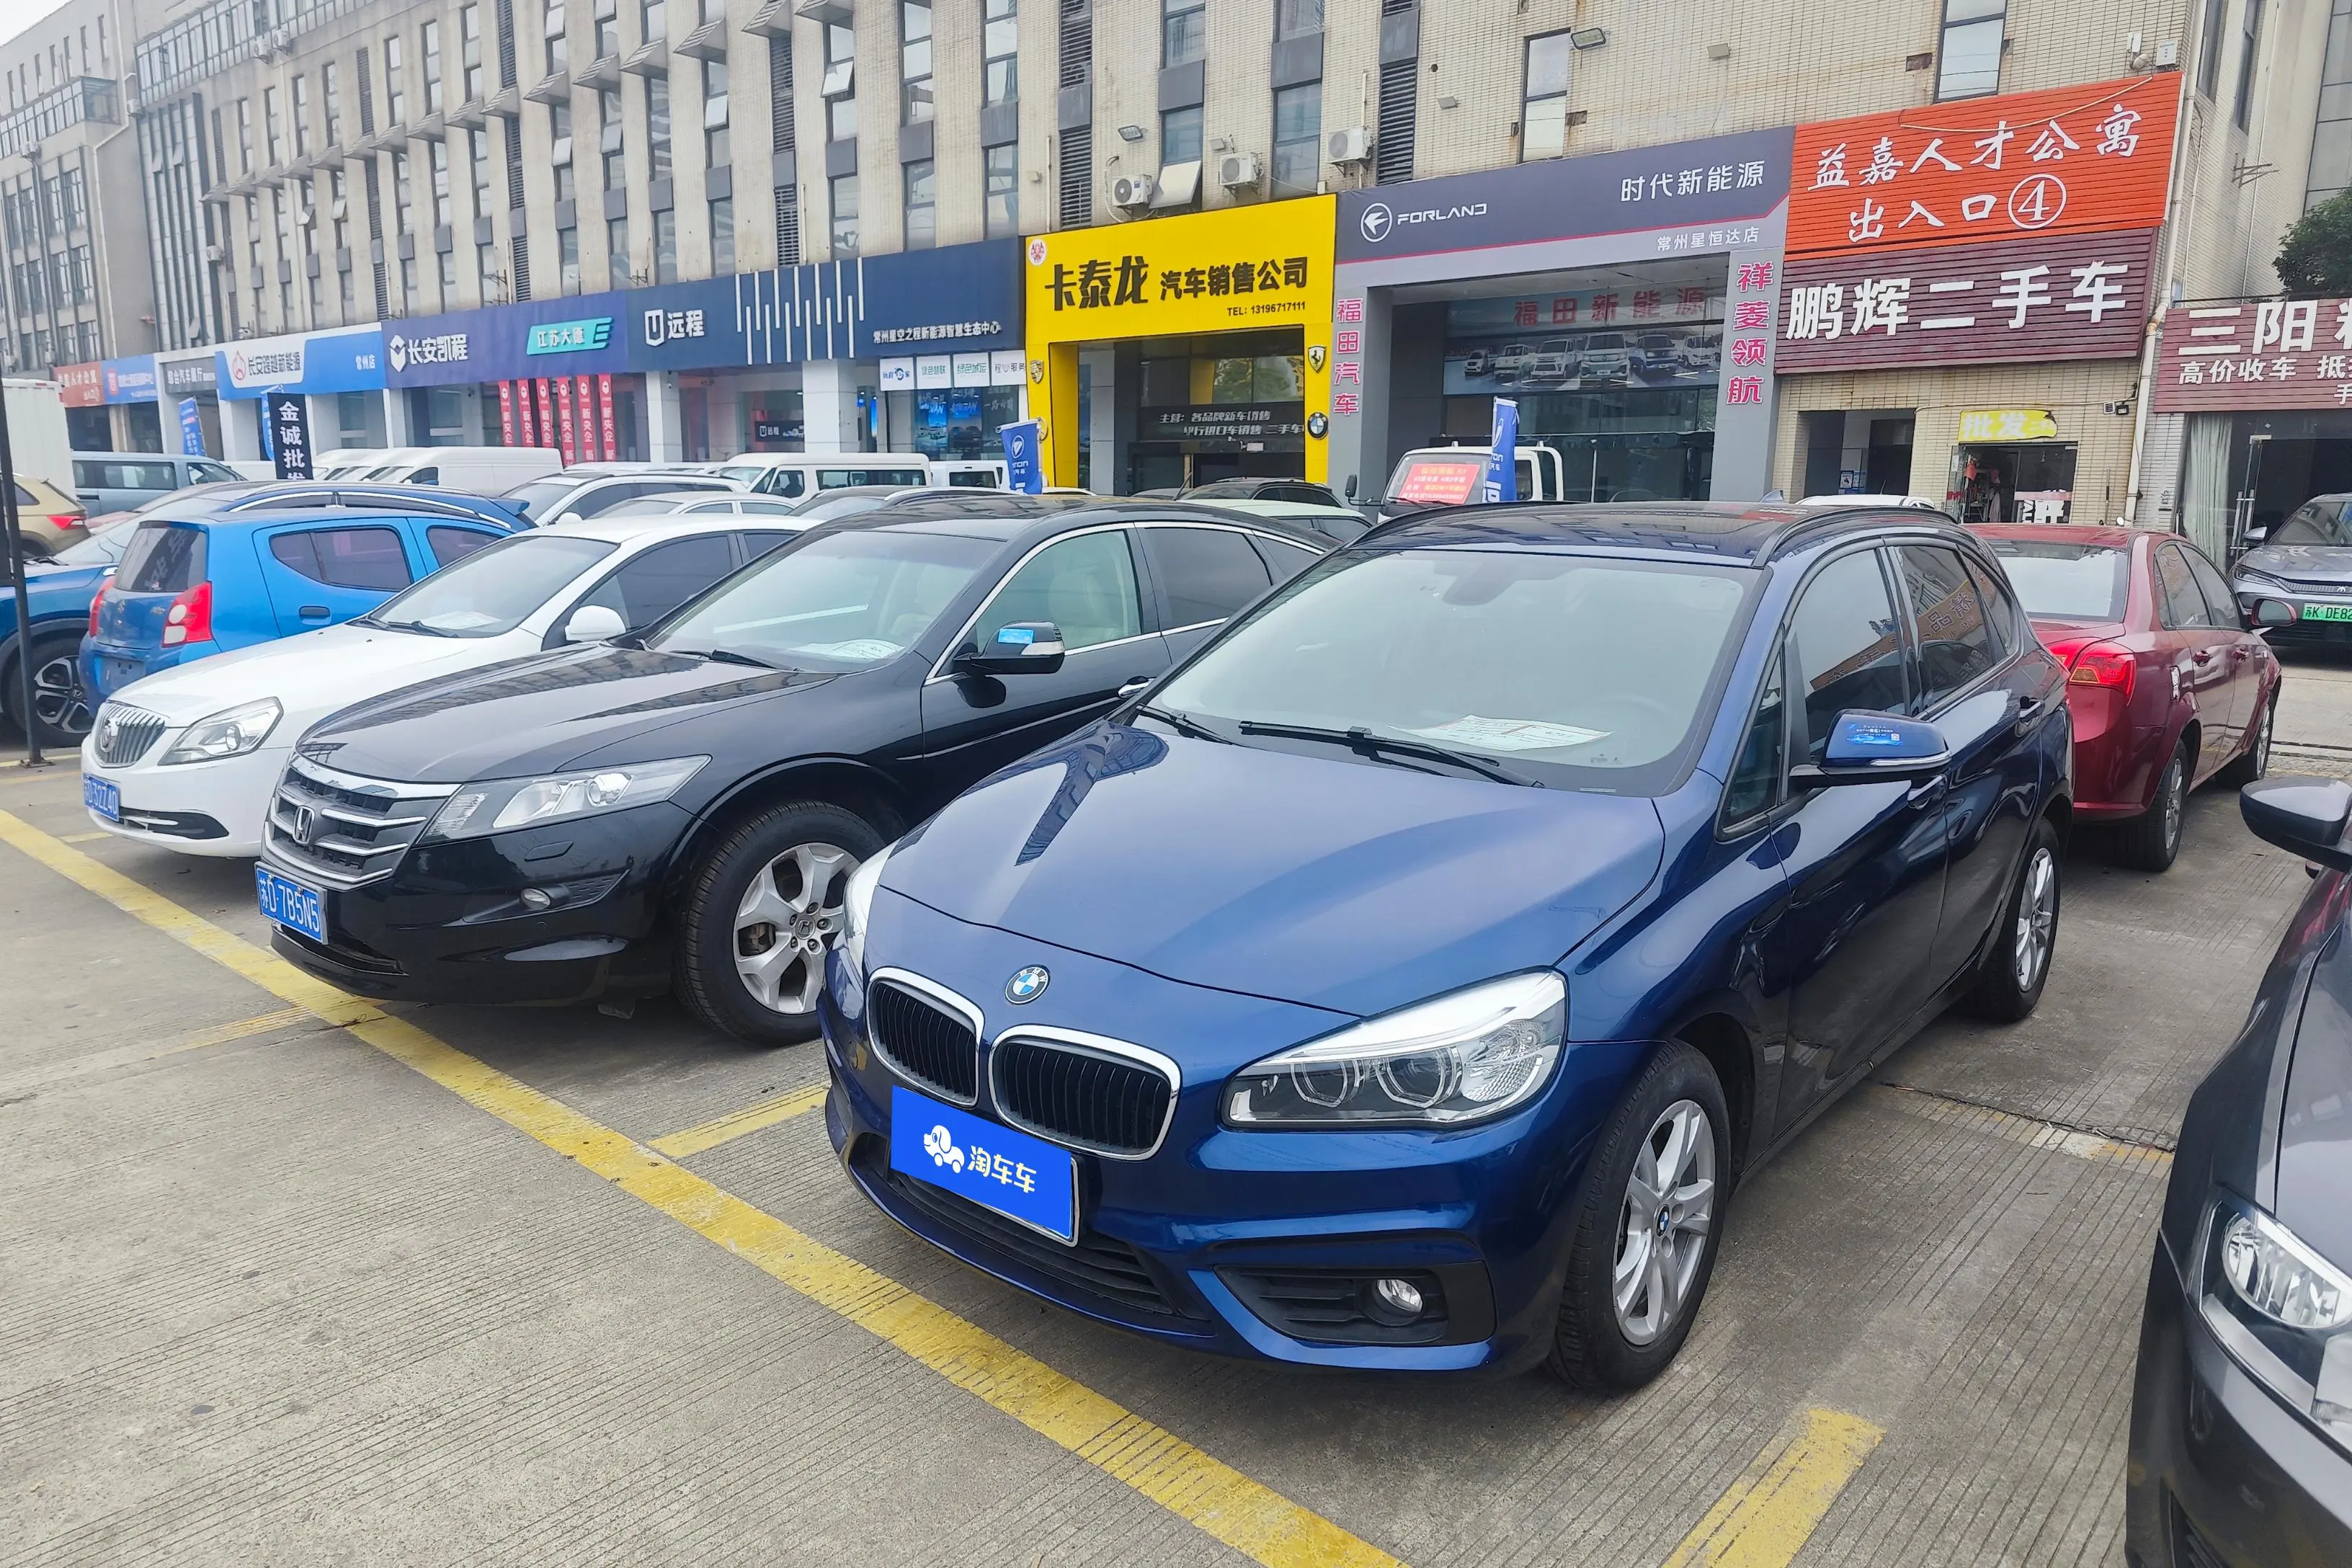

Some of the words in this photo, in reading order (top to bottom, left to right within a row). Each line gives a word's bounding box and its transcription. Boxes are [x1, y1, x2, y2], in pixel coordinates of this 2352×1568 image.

[1807, 104, 2142, 191] 益嘉人才公寓
[1621, 160, 1765, 202] 时代新能源
[1396, 202, 1488, 226] FORLAND
[1656, 226, 1760, 252] 常州星恒达店
[1045, 255, 1149, 311] 卡泰龙
[1159, 256, 1309, 300] 汽车销售公司
[1250, 300, 1306, 315] 13196717111
[1514, 287, 1705, 327] 福田新能源
[1784, 260, 2129, 340] 鹏辉二手车
[667, 309, 705, 339] 远程
[1726, 259, 1775, 406] 祥菱领航
[407, 333, 469, 365] 长安凯程
[1332, 298, 1363, 416] 福田汽车
[2178, 357, 2298, 385] 高价收车
[2317, 355, 2352, 380] 抵
[1265, 423, 1305, 435] 二手车
[1962, 412, 2026, 439] 批发
